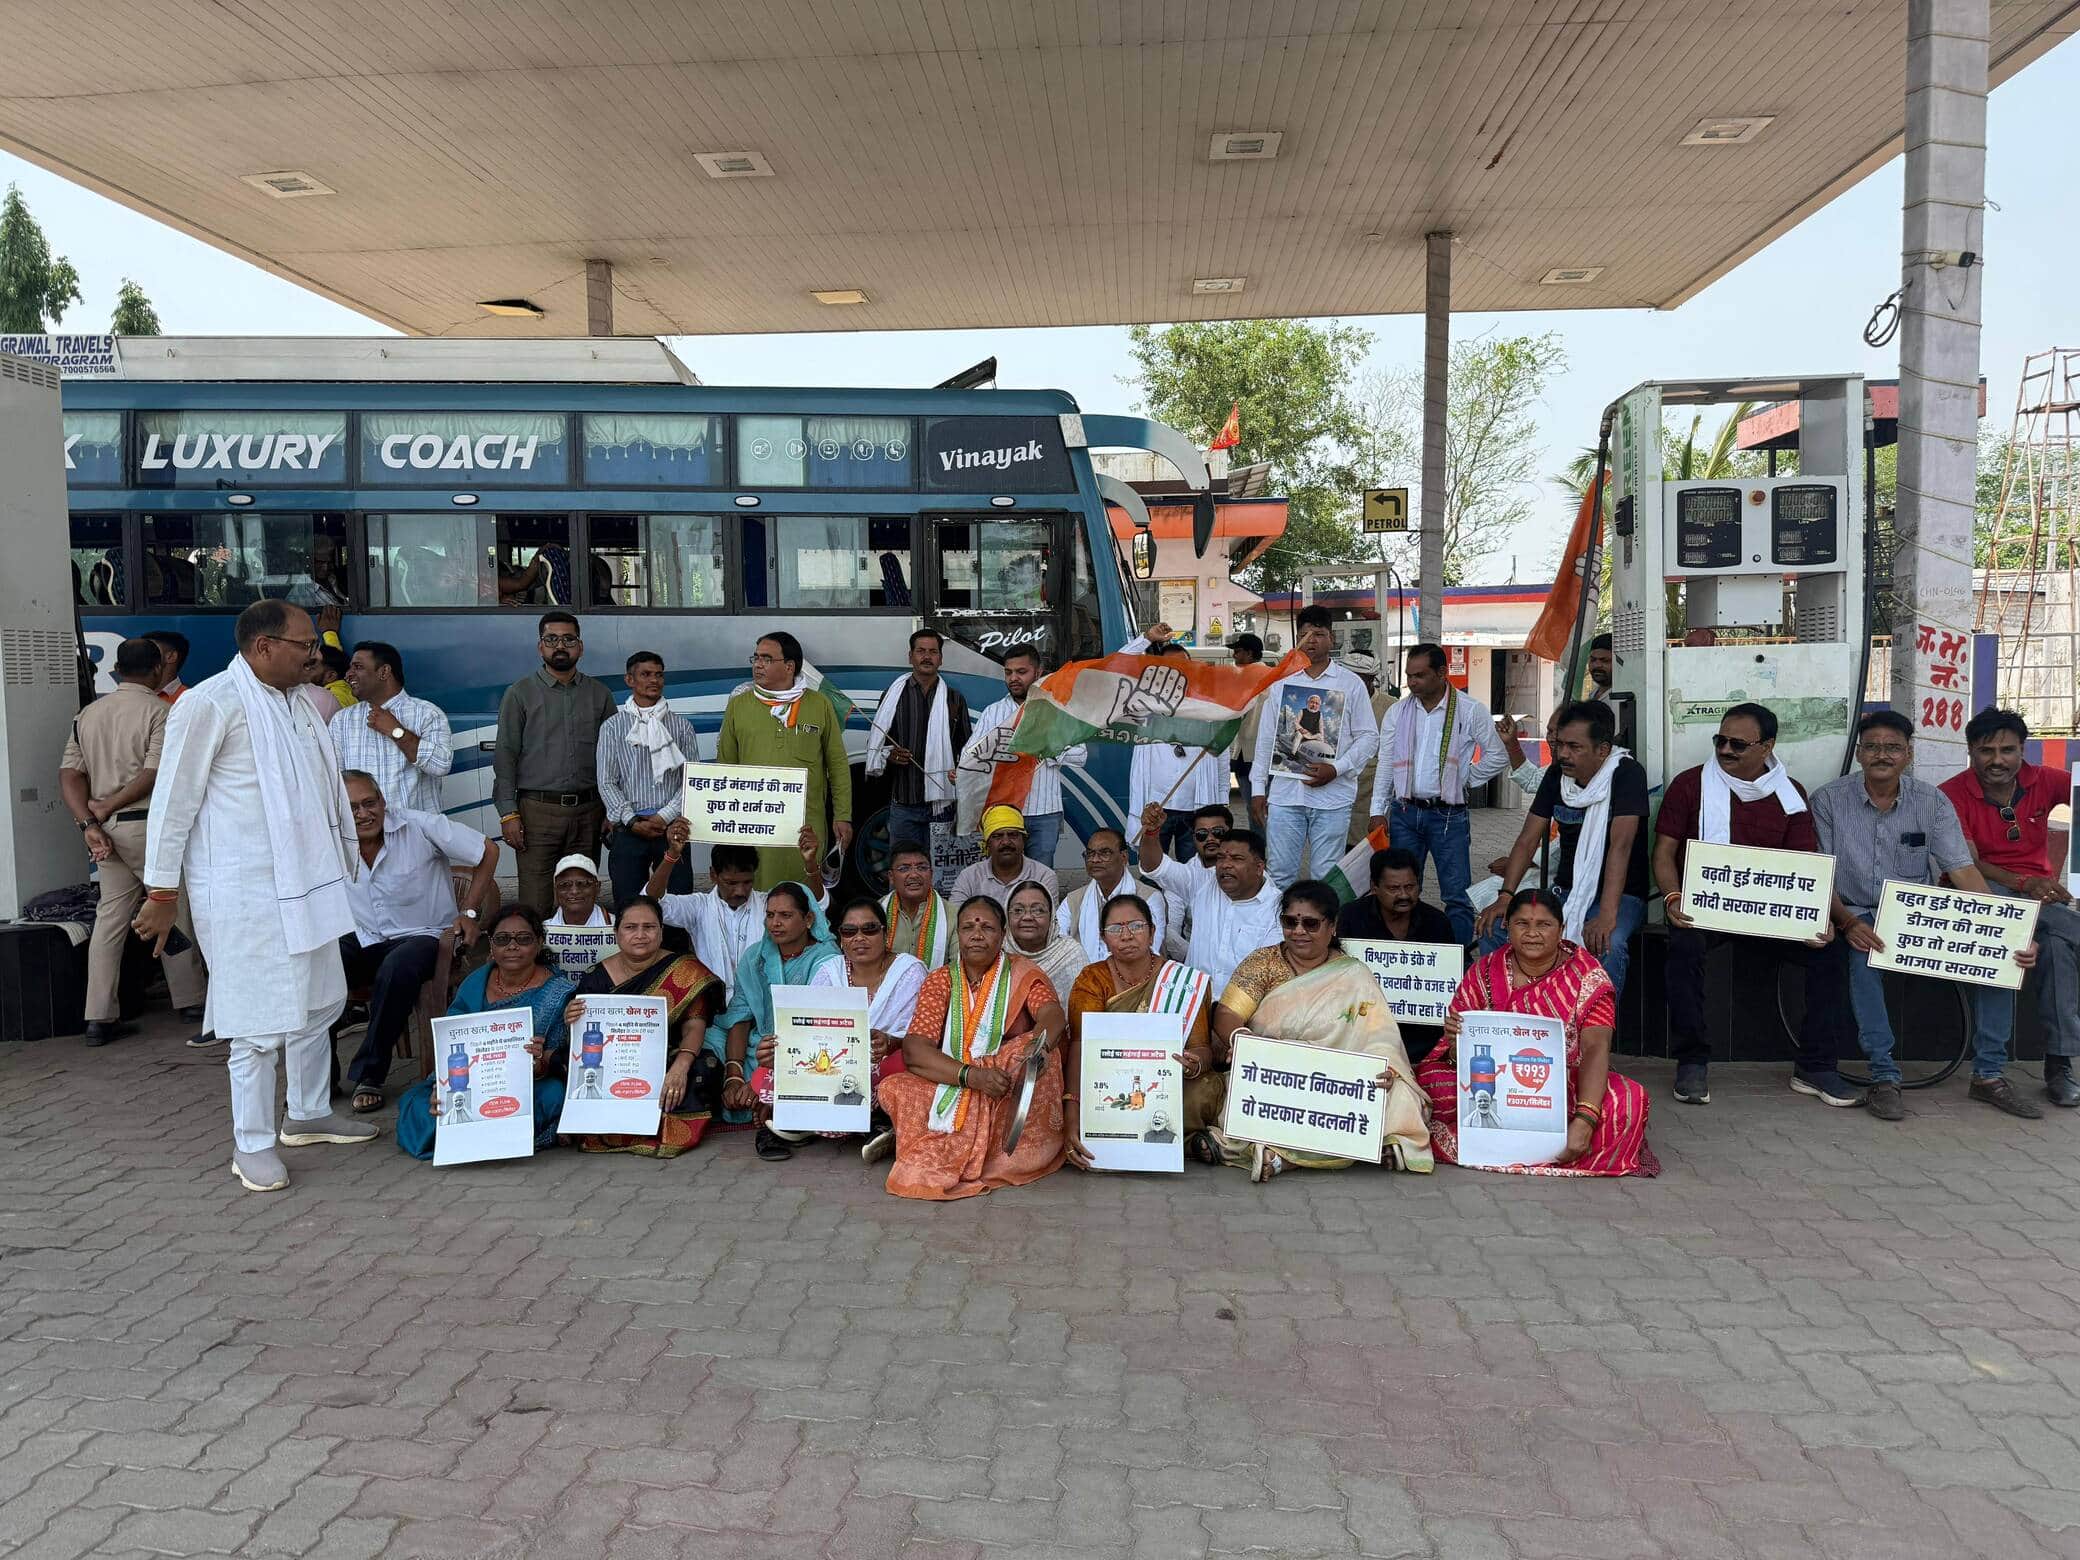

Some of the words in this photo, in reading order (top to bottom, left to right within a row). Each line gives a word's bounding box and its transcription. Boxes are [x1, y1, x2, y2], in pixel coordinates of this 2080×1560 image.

[0, 336, 51, 355] GRAWAL
[56, 335, 114, 354] TRAVELS
[141, 433, 336, 470] LUXURY
[381, 434, 538, 470] COACH
[939, 440, 1043, 471] Vinayak
[1622, 402, 1632, 496] REEN
[1367, 518, 1406, 529] PETROL
[979, 625, 1045, 653] Pilot
[1921, 697, 1963, 732] 288
[688, 777, 710, 790] बहुत
[713, 776, 727, 791] हुई
[729, 777, 765, 792] मंहगाई
[766, 779, 780, 792] की
[782, 782, 804, 793] मार
[706, 799, 726, 814] कुछ
[728, 798, 740, 812] तो
[743, 800, 763, 813] शर्म
[765, 800, 786, 814] करो
[711, 819, 736, 833] मोदी
[738, 823, 776, 835] सरकार
[1701, 865, 1732, 884] बढ़ती
[1733, 867, 1751, 888] हुई
[1753, 869, 1796, 890] मंहगाई
[1798, 877, 1816, 892] पर
[1692, 891, 1720, 909] मोदी
[1722, 897, 1767, 915] सरकार
[1769, 902, 1793, 918] हाय
[1795, 906, 1819, 922] हाय
[1896, 890, 1928, 907] बहुत
[1929, 895, 1951, 911] हुई
[1952, 897, 1993, 915] पेट्रोल
[1996, 904, 2025, 920] और
[1907, 911, 1951, 930] डीजल
[1952, 918, 1972, 934] की
[1975, 923, 2005, 938] मार
[548, 933, 573, 945] रहकर
[1896, 932, 1926, 948] कुछ
[1928, 936, 1944, 951] तो
[1947, 941, 1977, 955] शर्म
[1978, 945, 2008, 960] करो
[561, 949, 588, 964] दिखाते
[590, 948, 598, 964] हैं
[1400, 950, 1409, 964] के
[1410, 951, 1425, 966] डंके
[1427, 952, 1437, 967] में
[1895, 954, 1942, 971] भाजपा
[1945, 961, 1998, 979] सरकार
[1383, 975, 1411, 990] खराबी
[1413, 976, 1423, 990] के
[1424, 979, 1445, 992] वजह
[1447, 978, 1457, 993] से
[626, 1006, 641, 1016] खेल
[1407, 1003, 1418, 1016] पा
[1419, 1004, 1434, 1017] रहा
[449, 1026, 469, 1040] चुनाव
[490, 1022, 506, 1033] खेल
[1469, 1025, 1489, 1036] चुनाव
[1512, 1025, 1530, 1037] खेल
[1532, 1029, 1549, 1040] शुरू
[1515, 1064, 1546, 1077] ₹993
[1241, 1062, 1258, 1082] जो
[1260, 1068, 1308, 1090] सरकार
[1310, 1072, 1365, 1100] निकम्मी
[1367, 1080, 1377, 1101] है
[1242, 1095, 1256, 1116] वो
[1258, 1102, 1305, 1125] सरकार
[1308, 1112, 1356, 1133] बदलनी
[1358, 1113, 1369, 1135] है
